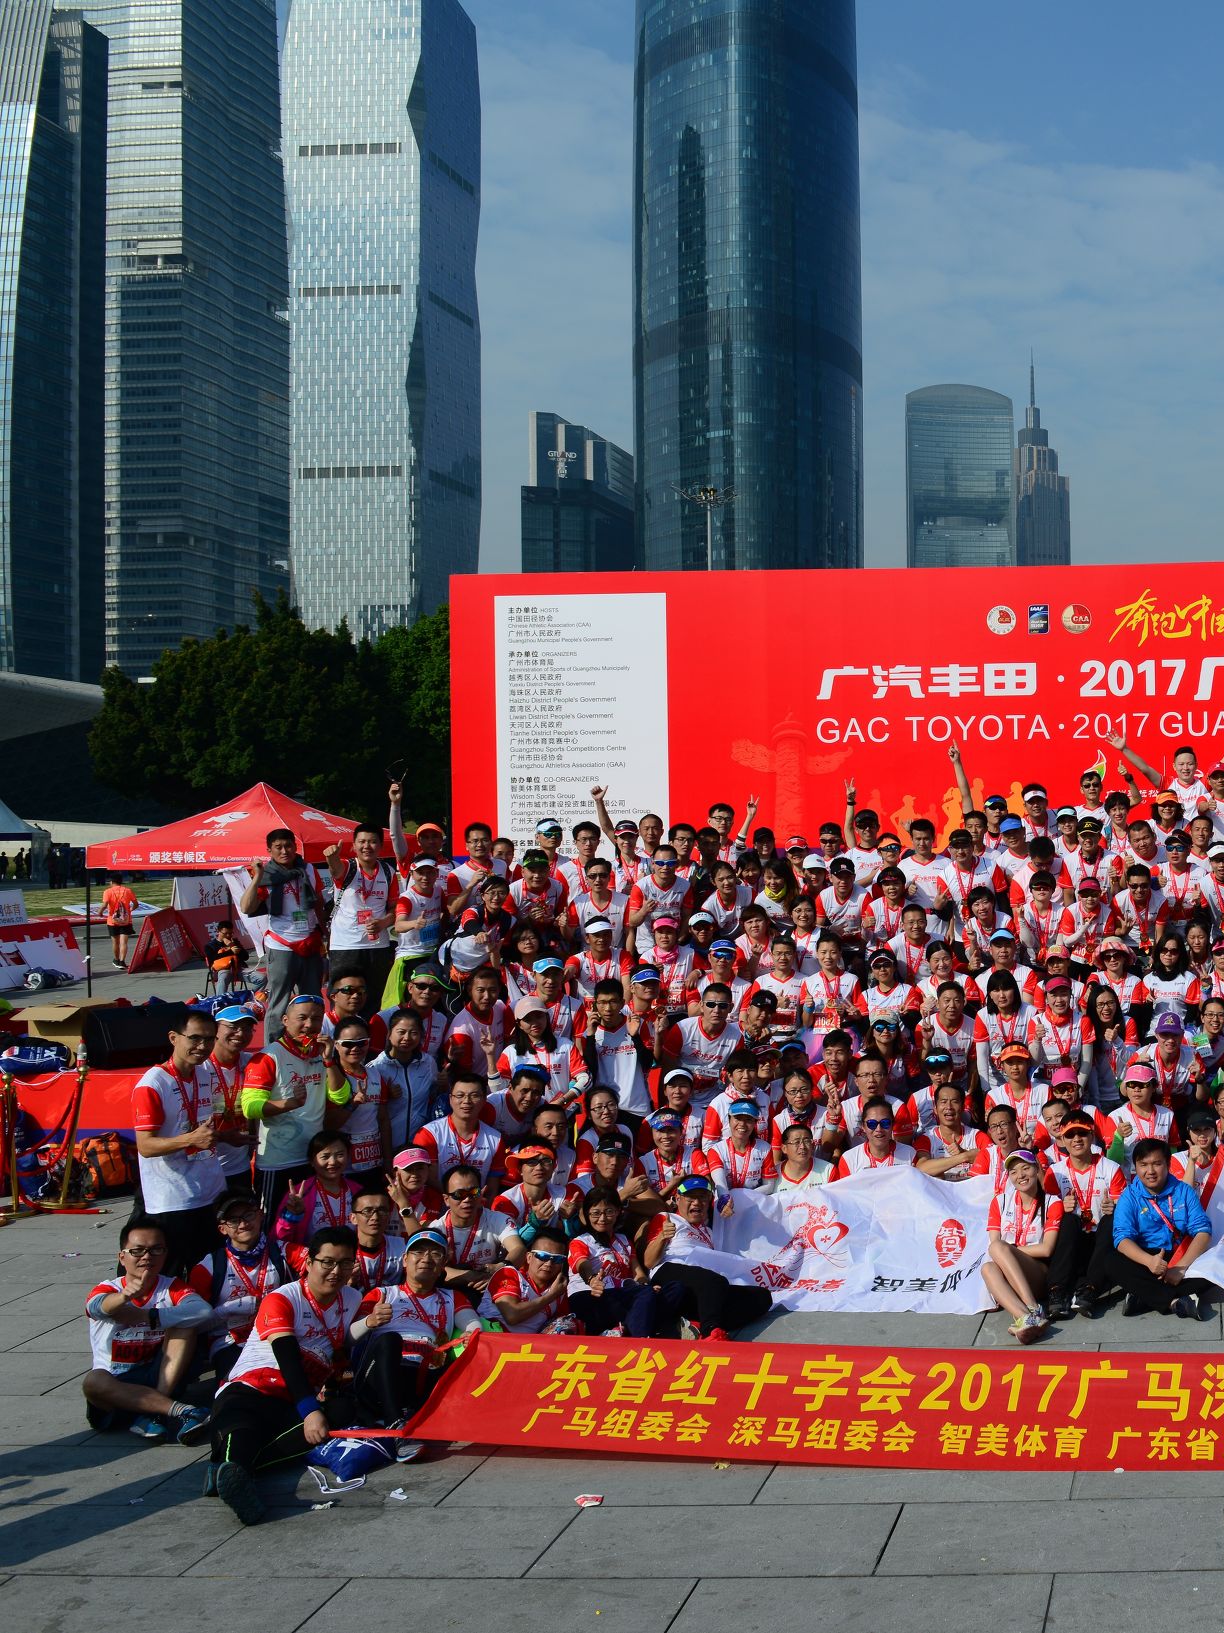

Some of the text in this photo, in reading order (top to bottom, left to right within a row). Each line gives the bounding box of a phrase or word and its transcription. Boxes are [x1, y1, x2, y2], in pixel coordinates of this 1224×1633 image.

[508, 658, 554, 666] 广州市体育局
[553, 696, 578, 704] People's
[817, 717, 889, 744] GAC
[510, 754, 563, 762] 广州市田径协会
[511, 800, 626, 808] 广州市城市建设投资集团限公司
[150, 852, 206, 864] 颁奖等候区
[522, 1405, 711, 1444] 广马组委会
[727, 1415, 917, 1453] 深马组委会
[938, 1421, 1088, 1459] 智美体育
